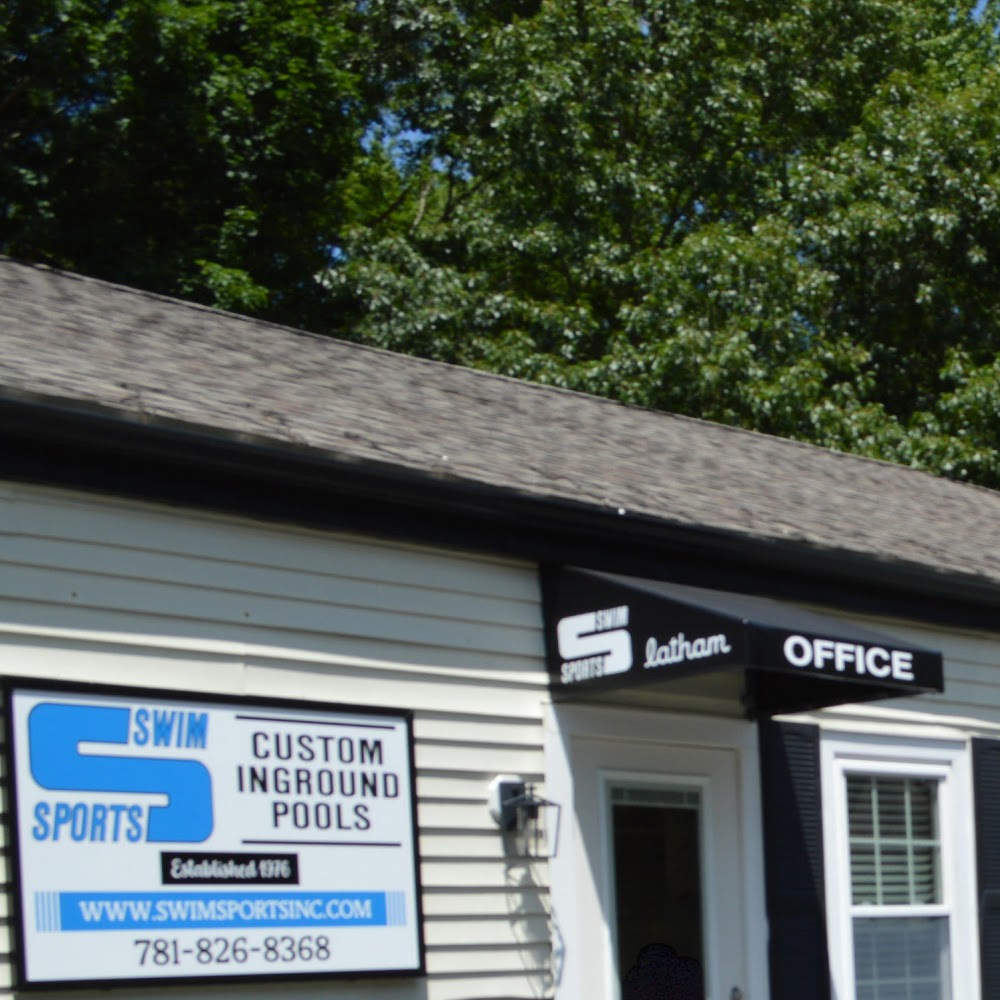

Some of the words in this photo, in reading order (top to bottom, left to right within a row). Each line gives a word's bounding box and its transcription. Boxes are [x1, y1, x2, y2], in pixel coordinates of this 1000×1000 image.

[643, 633, 732, 669] latham
[783, 635, 915, 681] OFFICE
[133, 708, 209, 749] SWIM
[252, 731, 383, 765] CUSTOM
[238, 765, 399, 799] INGROUND
[32, 801, 143, 843] SPORTS
[272, 801, 371, 831] POOLS
[170, 857, 258, 879] Established
[79, 898, 373, 922] WWW.SWIMSPORTSINC.COM
[134, 935, 332, 966] 781-826-8368
